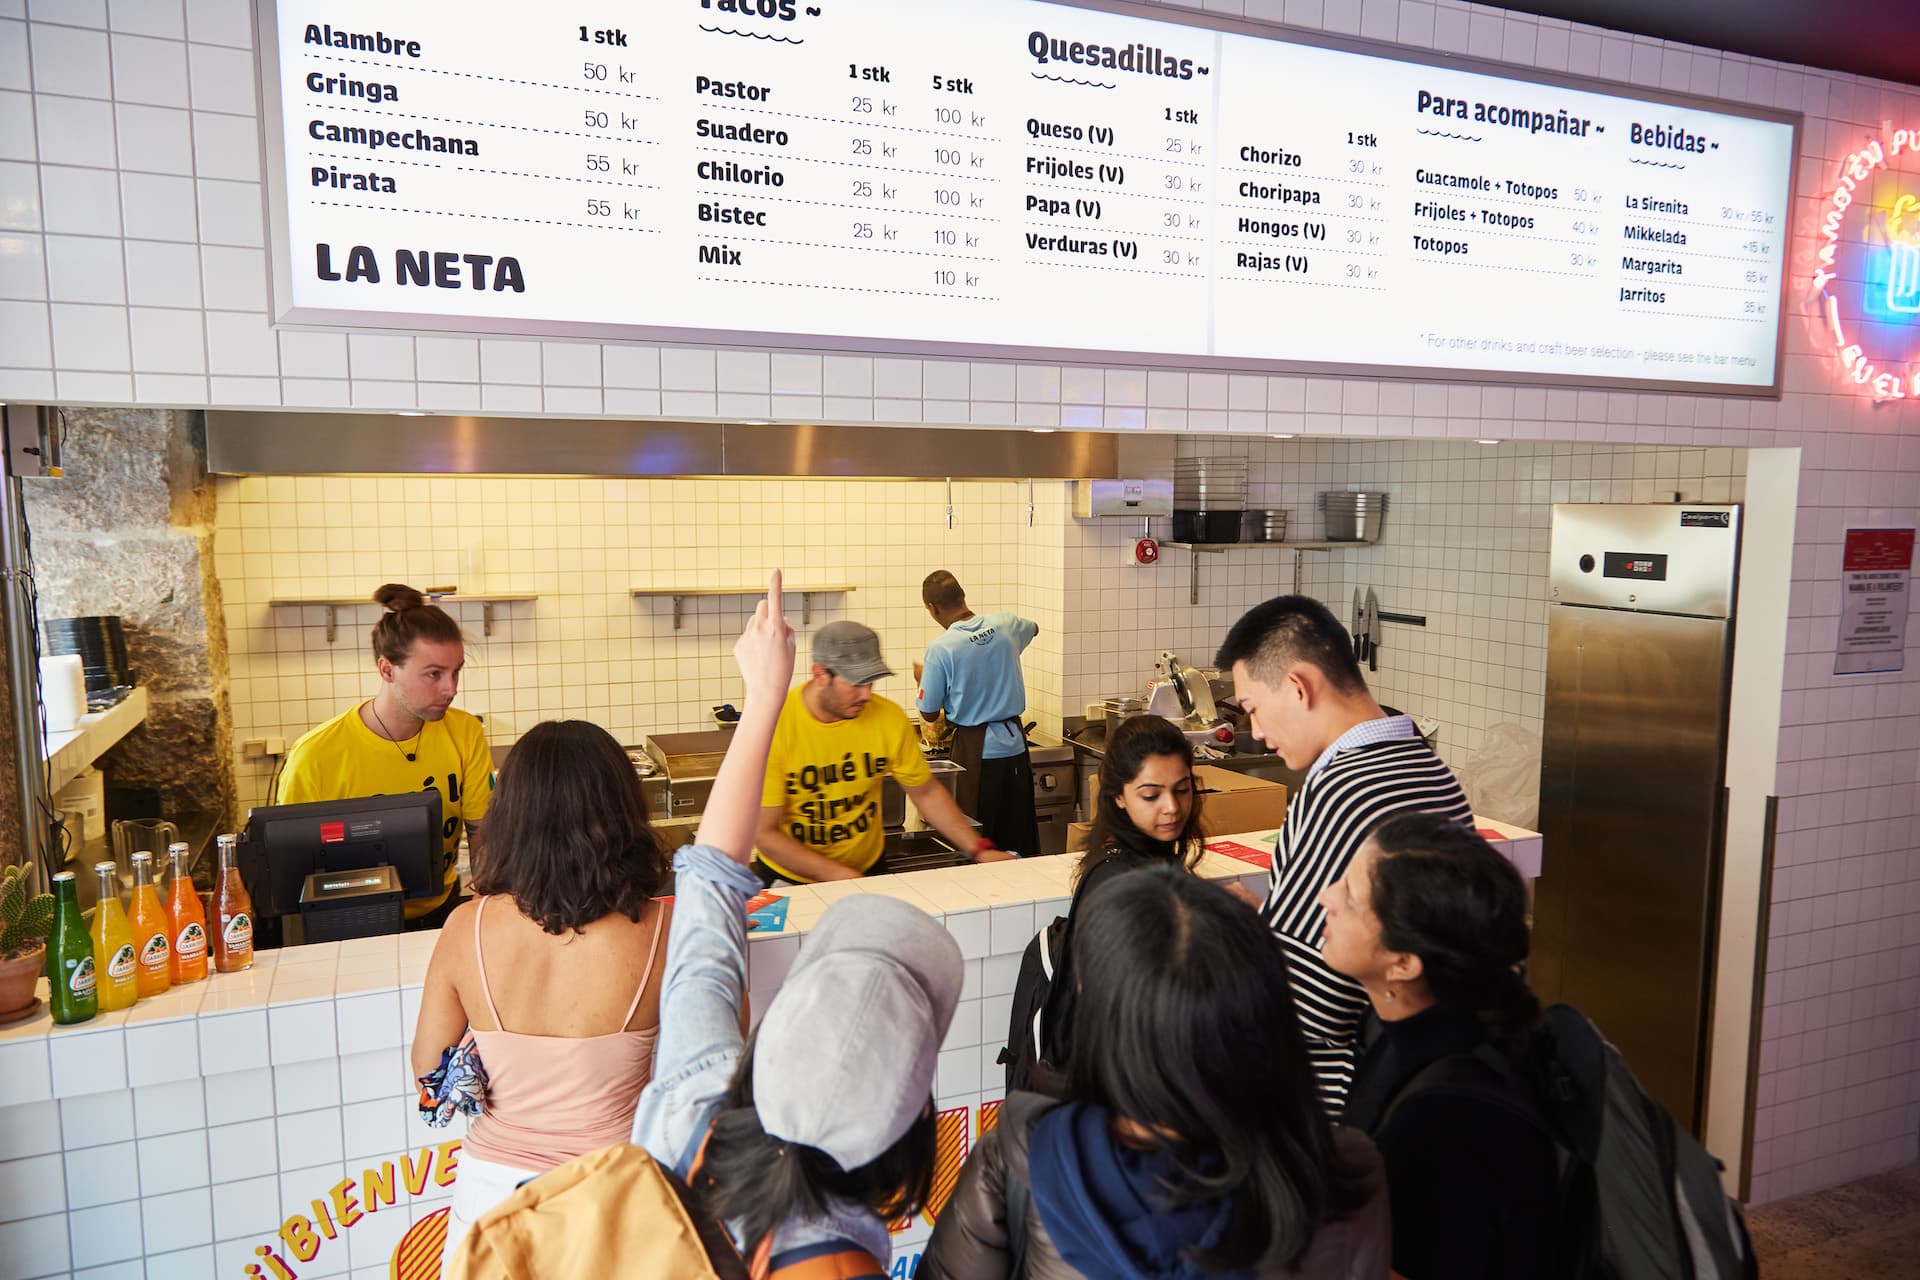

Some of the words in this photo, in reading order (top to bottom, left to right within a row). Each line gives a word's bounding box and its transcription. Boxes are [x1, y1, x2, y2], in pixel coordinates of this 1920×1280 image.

[304, 24, 422, 57] Alambre
[583, 62, 608, 81] 50
[619, 65, 637, 84] kr
[579, 26, 589, 42] 1
[594, 28, 628, 48] stk
[1028, 30, 1193, 80] Quesadillas
[849, 64, 858, 79] 1
[862, 66, 890, 83] stk
[933, 75, 943, 90] 5
[946, 77, 973, 94] stk
[306, 72, 399, 103] Gringa
[584, 110, 609, 129] 50
[621, 112, 638, 131] kr
[696, 76, 771, 102] Pastor
[852, 97, 872, 113] 25
[883, 100, 898, 116] kr
[934, 108, 962, 124] 100
[971, 111, 986, 127] kr
[1164, 108, 1172, 121] 1
[1176, 109, 1198, 125] stk
[1417, 90, 1468, 120] Para
[1475, 101, 1590, 138] acompañar
[308, 120, 480, 157] Campechana
[586, 154, 610, 173] 55
[622, 157, 640, 177] kr
[696, 119, 789, 147] Suadero
[852, 139, 872, 155] 25
[883, 142, 898, 158] kr
[934, 149, 961, 165] 100
[970, 153, 985, 169] kr
[1027, 118, 1083, 141] Queso
[1088, 125, 1114, 147] (V)
[1165, 138, 1182, 153] 25
[1190, 141, 1202, 155] kr
[1347, 132, 1354, 145] 1
[1357, 133, 1378, 148] stk
[1630, 122, 1706, 154] Bebidas
[1026, 157, 1094, 180] Frijoles
[1099, 164, 1124, 185] (V)
[1164, 175, 1181, 190] 30
[1189, 178, 1202, 192] kr
[1240, 146, 1302, 167] Chorizo
[1349, 159, 1365, 173] 30
[1371, 161, 1383, 175] kr
[310, 167, 397, 194] Pirata
[586, 199, 612, 217] 55
[623, 201, 641, 221] kr
[697, 162, 784, 187] Chilorio
[852, 181, 872, 198] 25
[883, 184, 898, 200] kr
[934, 190, 961, 206] 100
[970, 192, 985, 208] kr
[1238, 182, 1321, 206] Choripapa
[1348, 195, 1364, 209] 30
[1370, 197, 1382, 211] kr
[1416, 169, 1491, 191] Guacamole
[1505, 180, 1558, 200] Totopos
[1573, 188, 1588, 202] 50
[1593, 191, 1603, 204] kr
[1025, 195, 1070, 216] Papa
[1075, 199, 1101, 220] (V)
[1163, 213, 1181, 227] 30
[1189, 215, 1201, 230] kr
[1414, 202, 1466, 222] Frijoles
[1481, 210, 1534, 229] Totopos
[1572, 220, 1586, 234] 40
[1589, 223, 1599, 236] kr
[1625, 195, 1638, 209] La
[1642, 196, 1689, 215] Sirenita
[697, 203, 767, 226] Bistec
[853, 223, 873, 239] 25
[884, 224, 899, 240] kr
[934, 230, 956, 245] 110
[965, 232, 980, 248] kr
[1238, 217, 1299, 239] Hongos
[1303, 221, 1326, 241] (V)
[1346, 230, 1362, 244] 30
[1368, 232, 1380, 246] kr
[1624, 225, 1687, 245] Mikkelada
[699, 245, 742, 266] Mix
[934, 270, 956, 285] 110
[965, 272, 980, 288] kr
[1025, 233, 1107, 256] Verduras
[1112, 240, 1138, 260] (V)
[1163, 250, 1180, 265] 30
[1188, 252, 1200, 267] kr
[1237, 253, 1281, 273] Rajas
[1285, 254, 1309, 274] (V)
[1345, 265, 1361, 278] 30
[1367, 266, 1379, 280] kr
[1413, 236, 1468, 255] Totopos
[1570, 252, 1585, 266] 30
[1587, 255, 1597, 268] kr
[1622, 257, 1683, 276] Margarita
[316, 243, 380, 284] LA
[395, 249, 526, 293] NETA
[1620, 287, 1666, 304] Jarritos
[1428, 333, 1446, 348] For
[1449, 336, 1477, 349] other
[1481, 338, 1513, 352] drinks
[1517, 340, 1536, 353] and
[1539, 341, 1562, 354] craft
[1565, 343, 1588, 356] beer
[1591, 345, 1634, 360] selection
